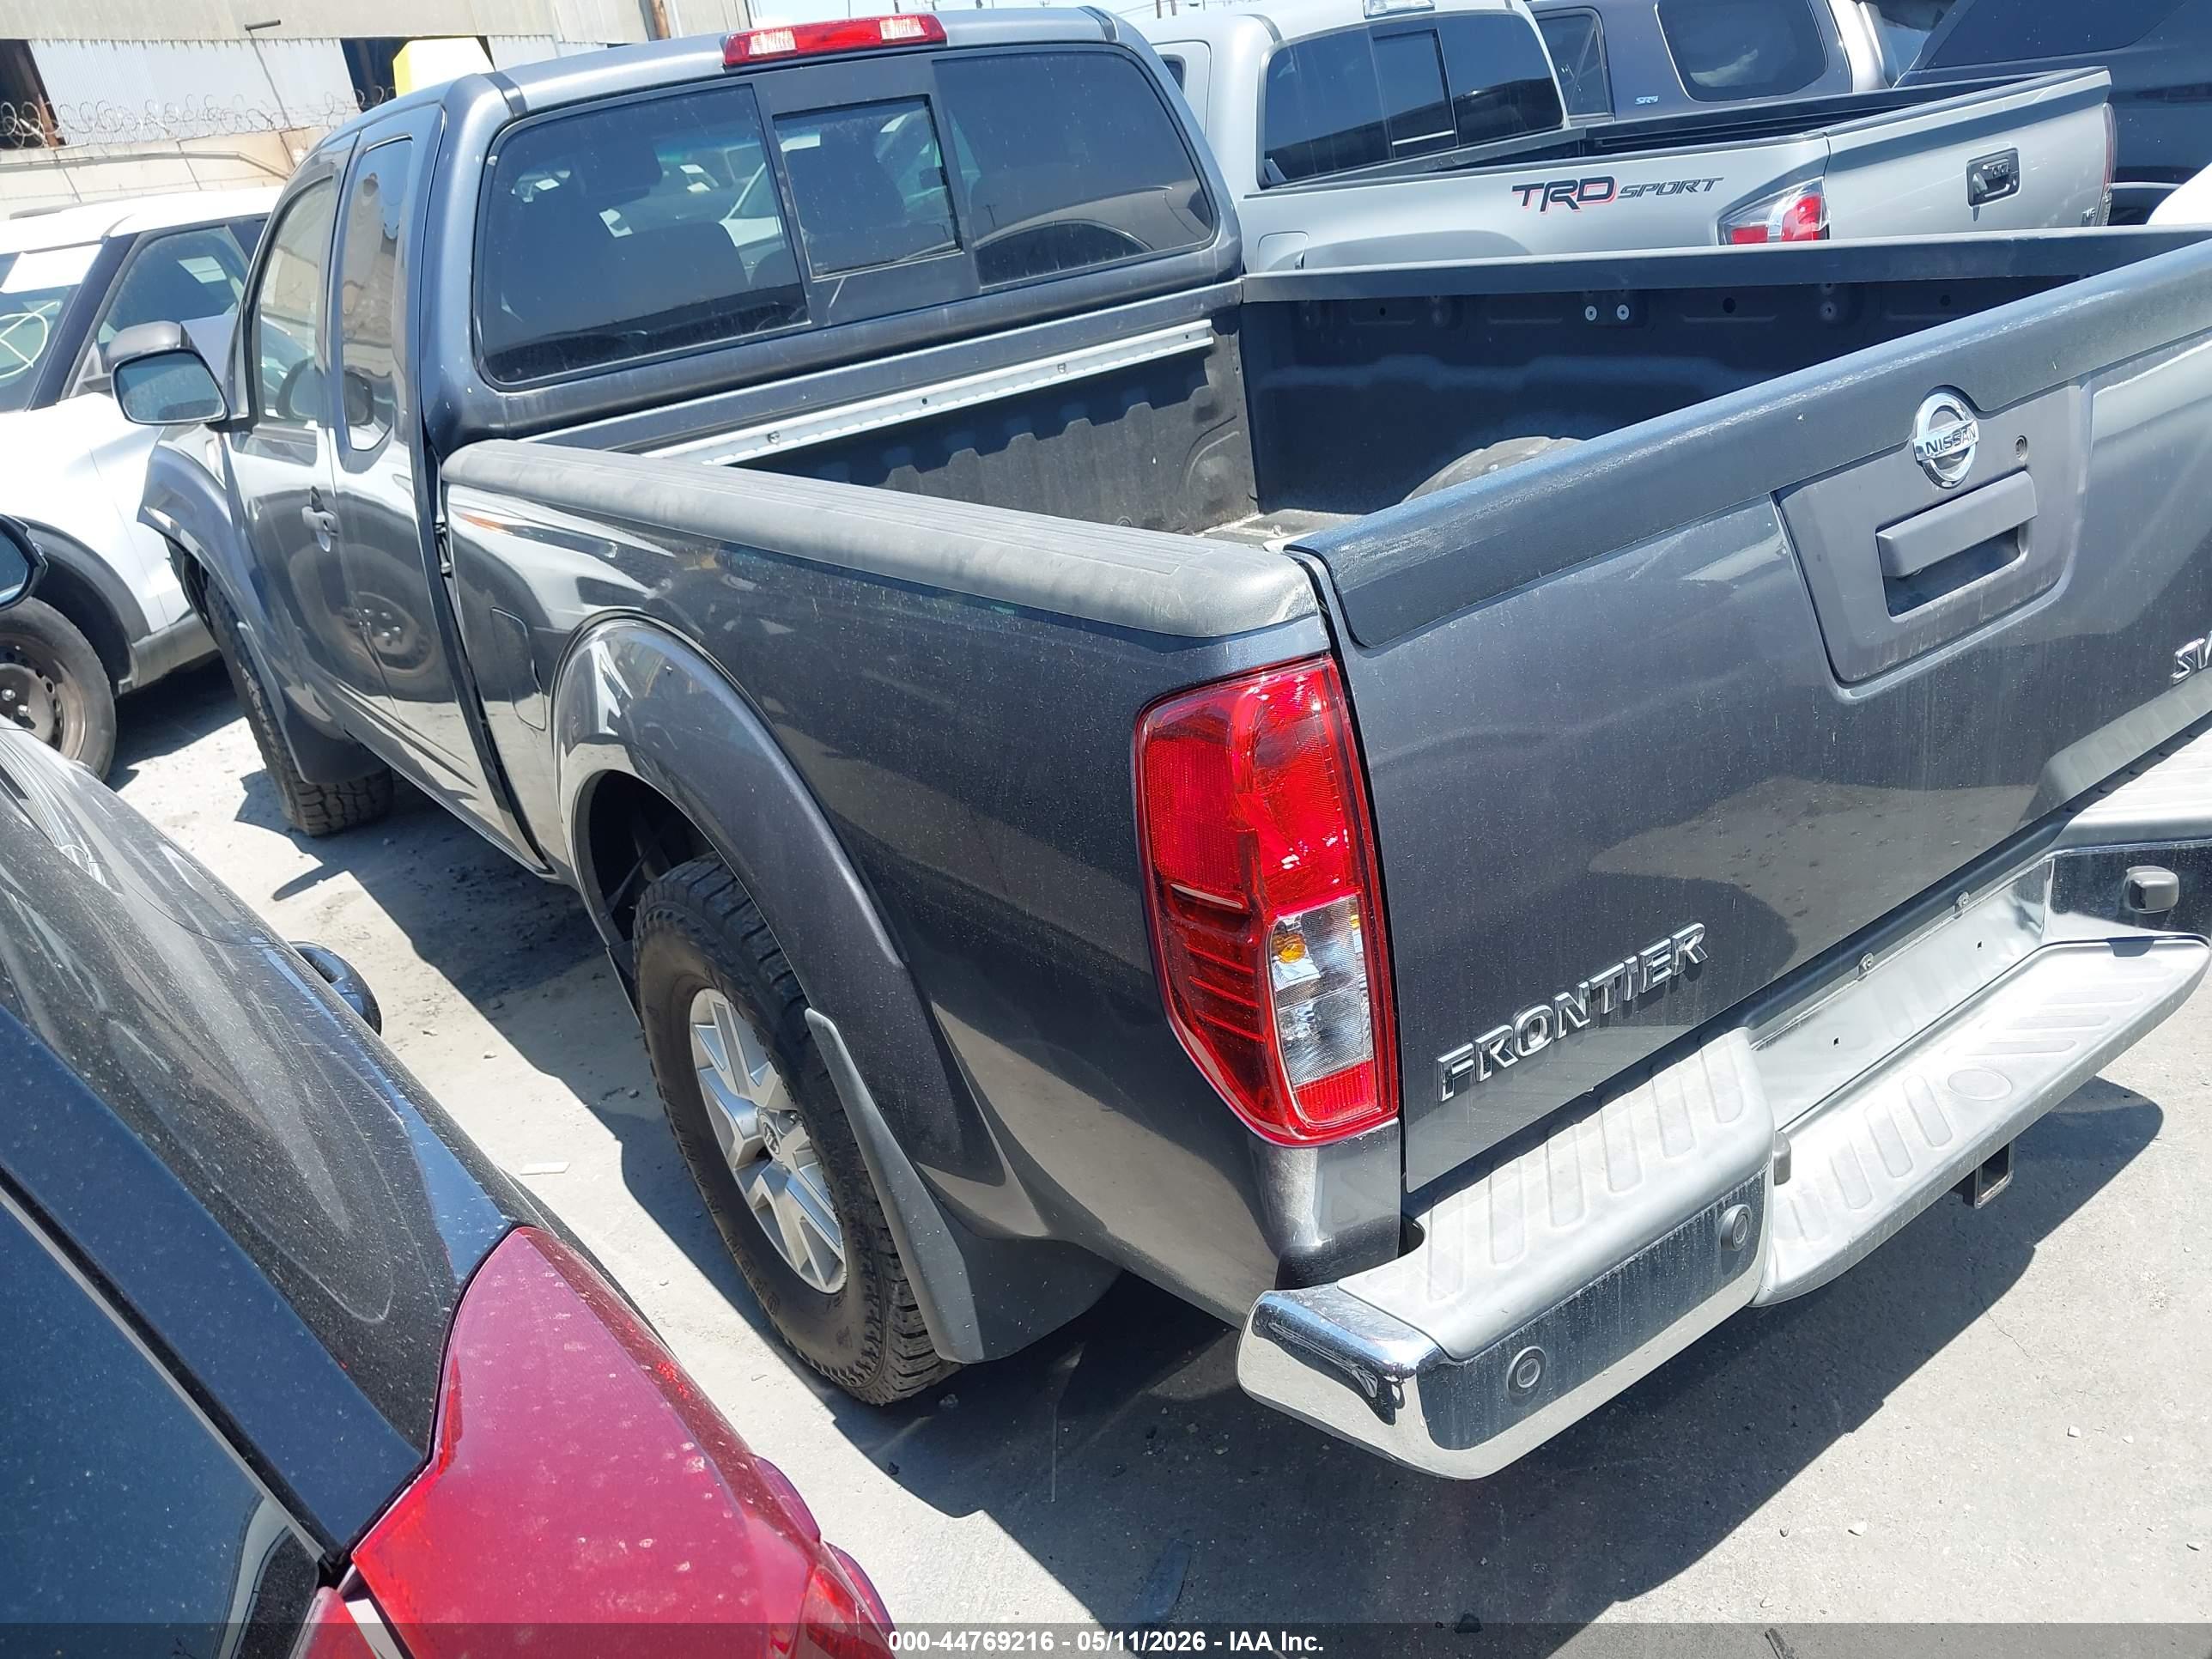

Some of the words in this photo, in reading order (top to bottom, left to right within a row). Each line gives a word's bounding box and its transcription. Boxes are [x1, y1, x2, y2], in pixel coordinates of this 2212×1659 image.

[1512, 176, 1618, 214] TRD
[1618, 177, 1724, 199] SPORT
[1925, 427, 1977, 455] NISSAN
[1437, 922, 1709, 1103] FRONTIER
